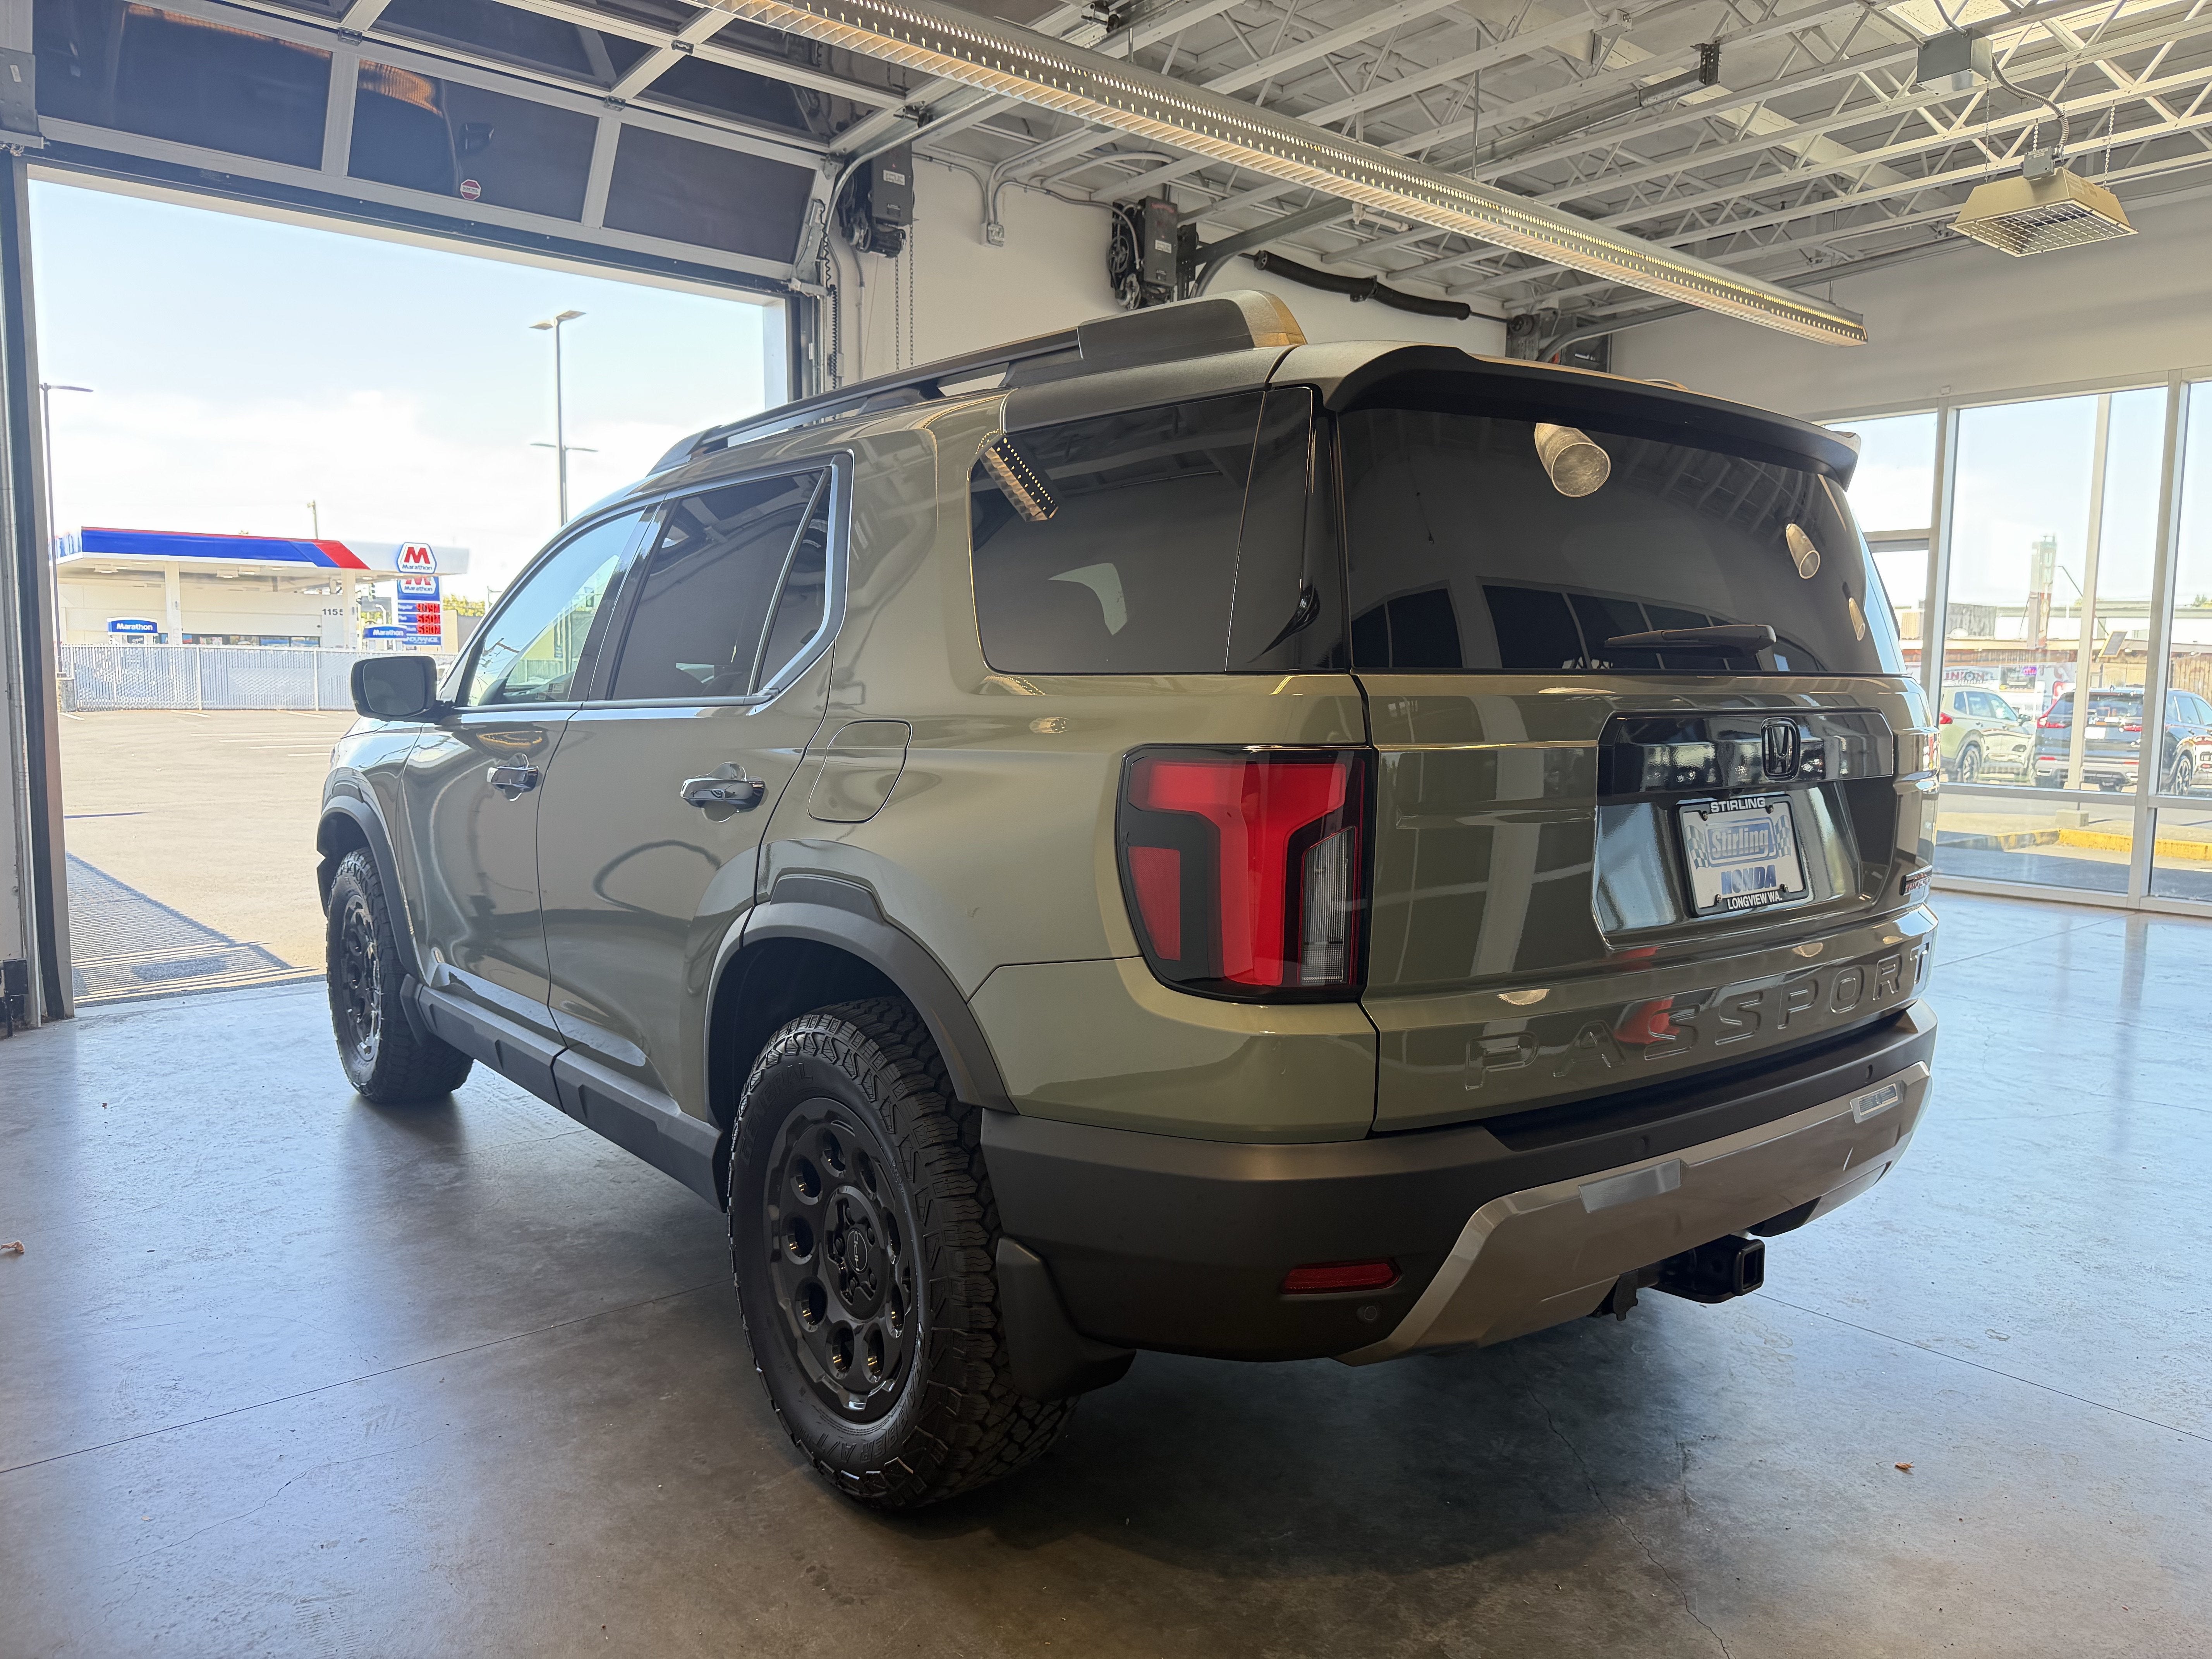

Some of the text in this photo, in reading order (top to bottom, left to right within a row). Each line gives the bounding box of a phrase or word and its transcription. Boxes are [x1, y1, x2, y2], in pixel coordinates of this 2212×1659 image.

[404, 547, 430, 564] M
[1711, 797, 1765, 812] STIRLING
[1711, 827, 1769, 858] Stirling
[1721, 864, 1777, 895] HONDA
[1727, 891, 1782, 910] LONGVIEW WA.
[1465, 942, 1930, 1091] PASSPORT
[739, 1062, 812, 1166] GENERAL
